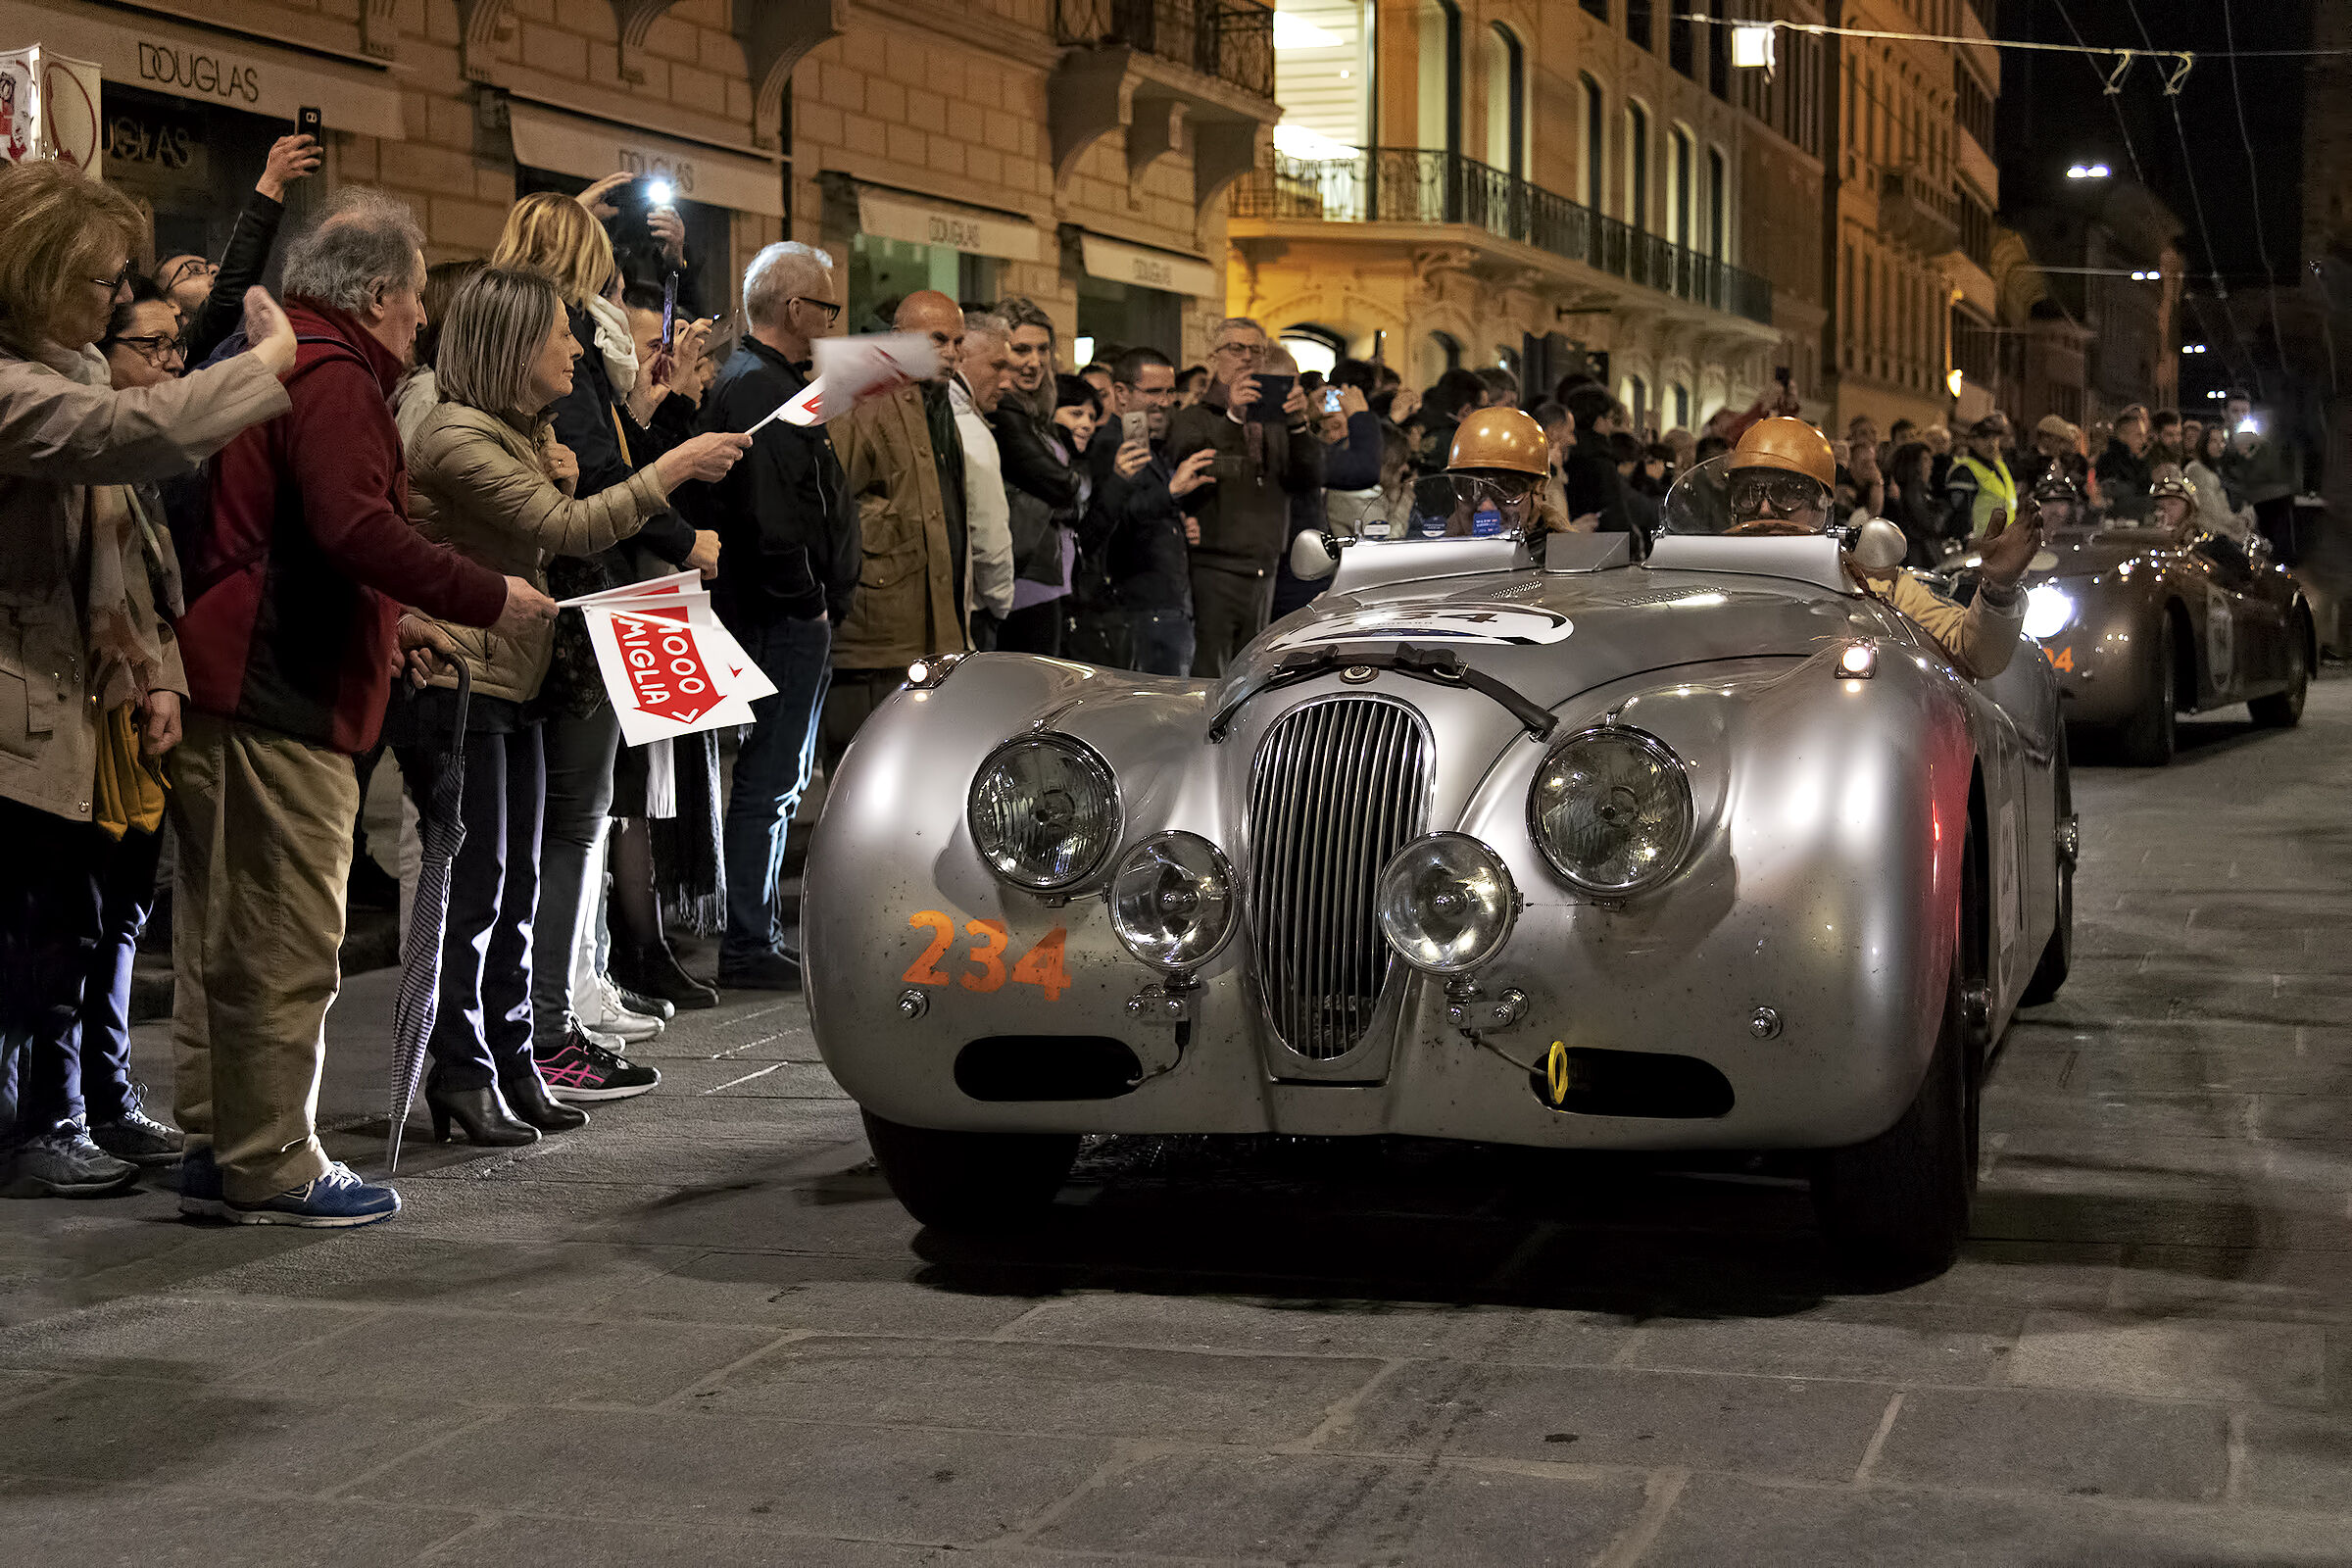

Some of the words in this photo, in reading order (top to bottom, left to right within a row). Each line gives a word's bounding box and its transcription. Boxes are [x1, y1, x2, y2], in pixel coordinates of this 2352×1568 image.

[138, 41, 259, 103] DOUGLAS
[618, 148, 694, 193] DOAS
[617, 617, 671, 705] MIGLIA
[657, 626, 707, 695] 1000
[901, 908, 1072, 1002] 234
